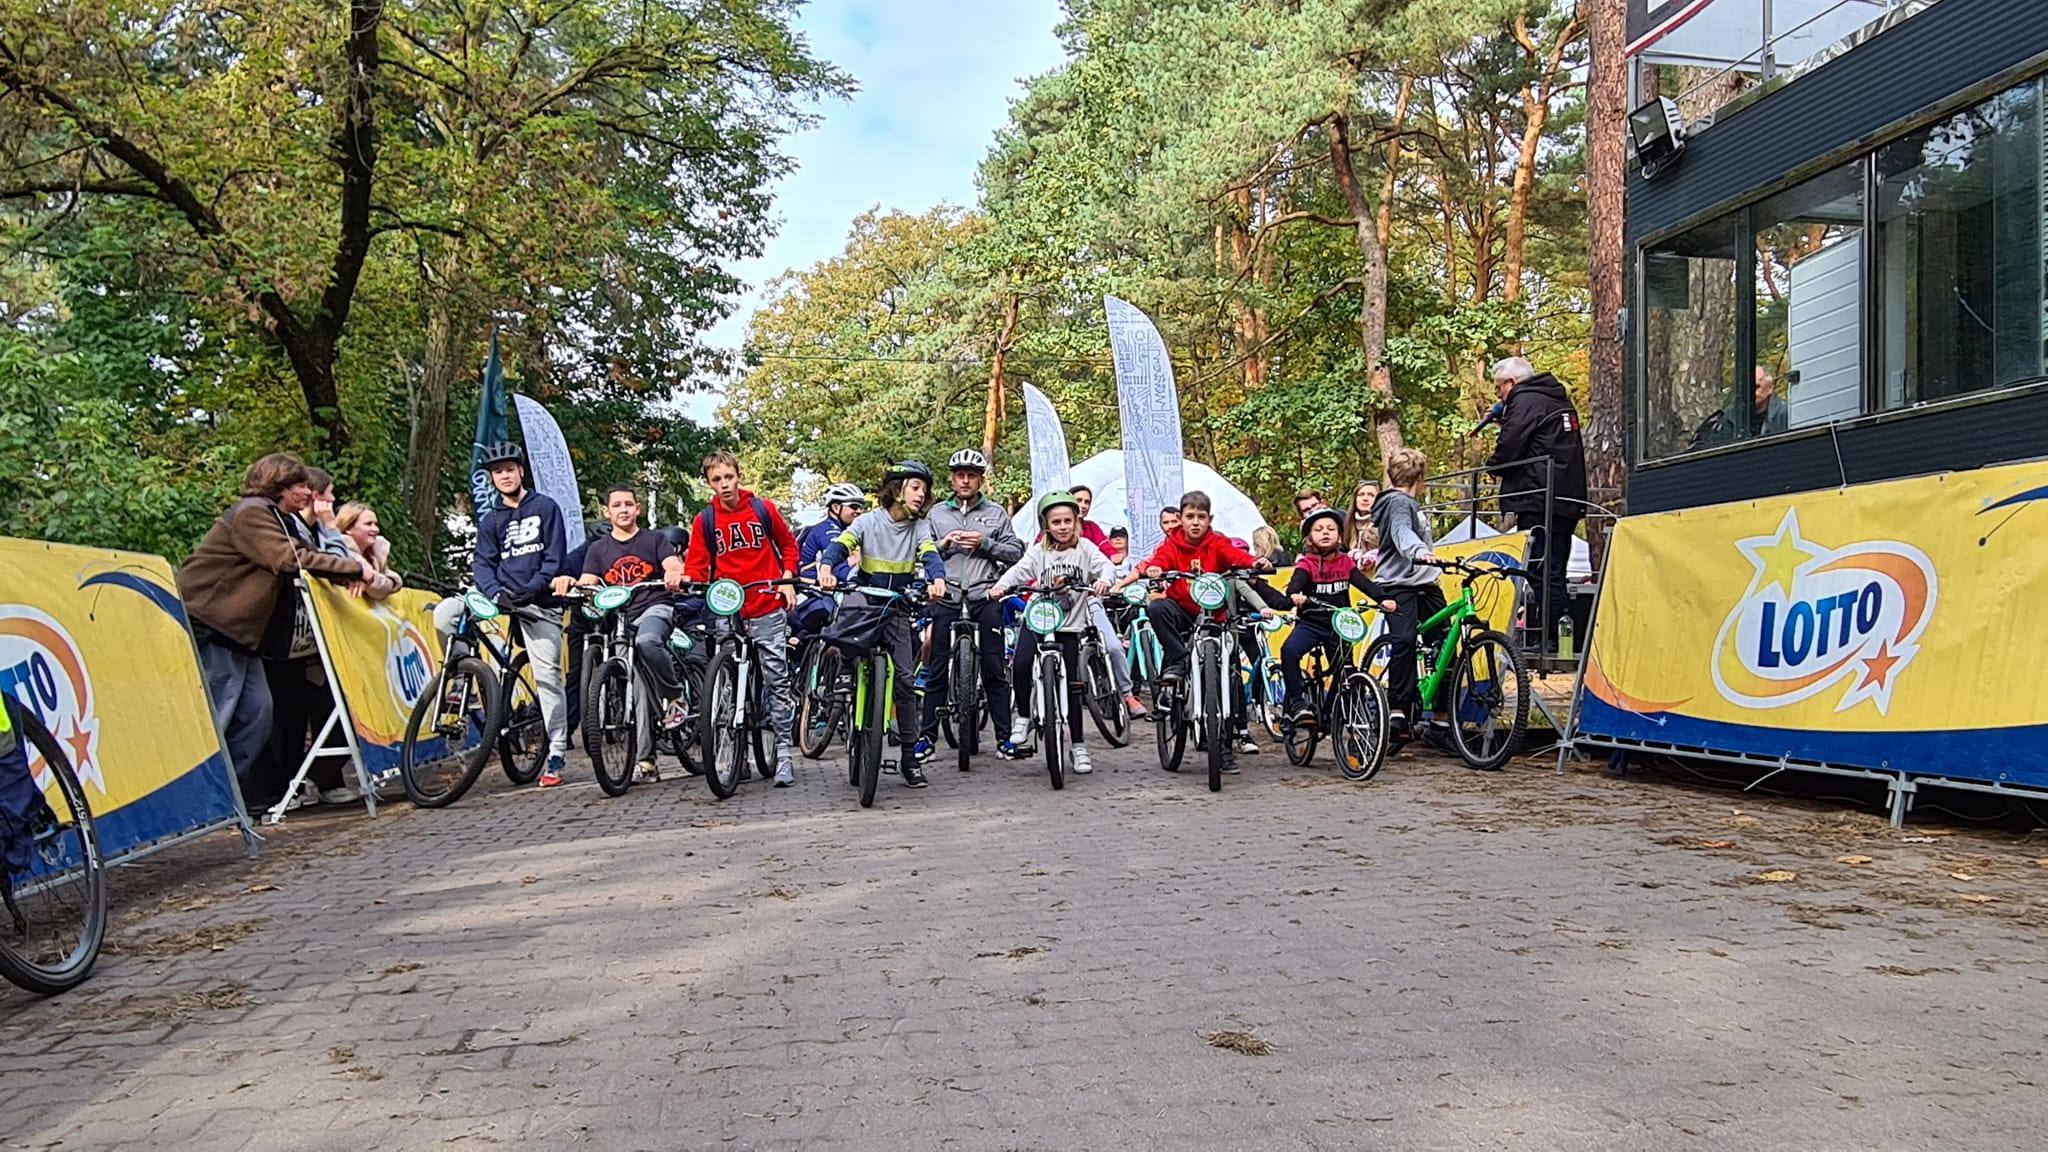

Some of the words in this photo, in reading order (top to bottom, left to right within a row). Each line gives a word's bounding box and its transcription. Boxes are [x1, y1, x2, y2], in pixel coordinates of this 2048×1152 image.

[615, 563, 642, 588] NYC
[1758, 581, 1883, 668] LOTTO
[395, 646, 426, 702] LOTTO
